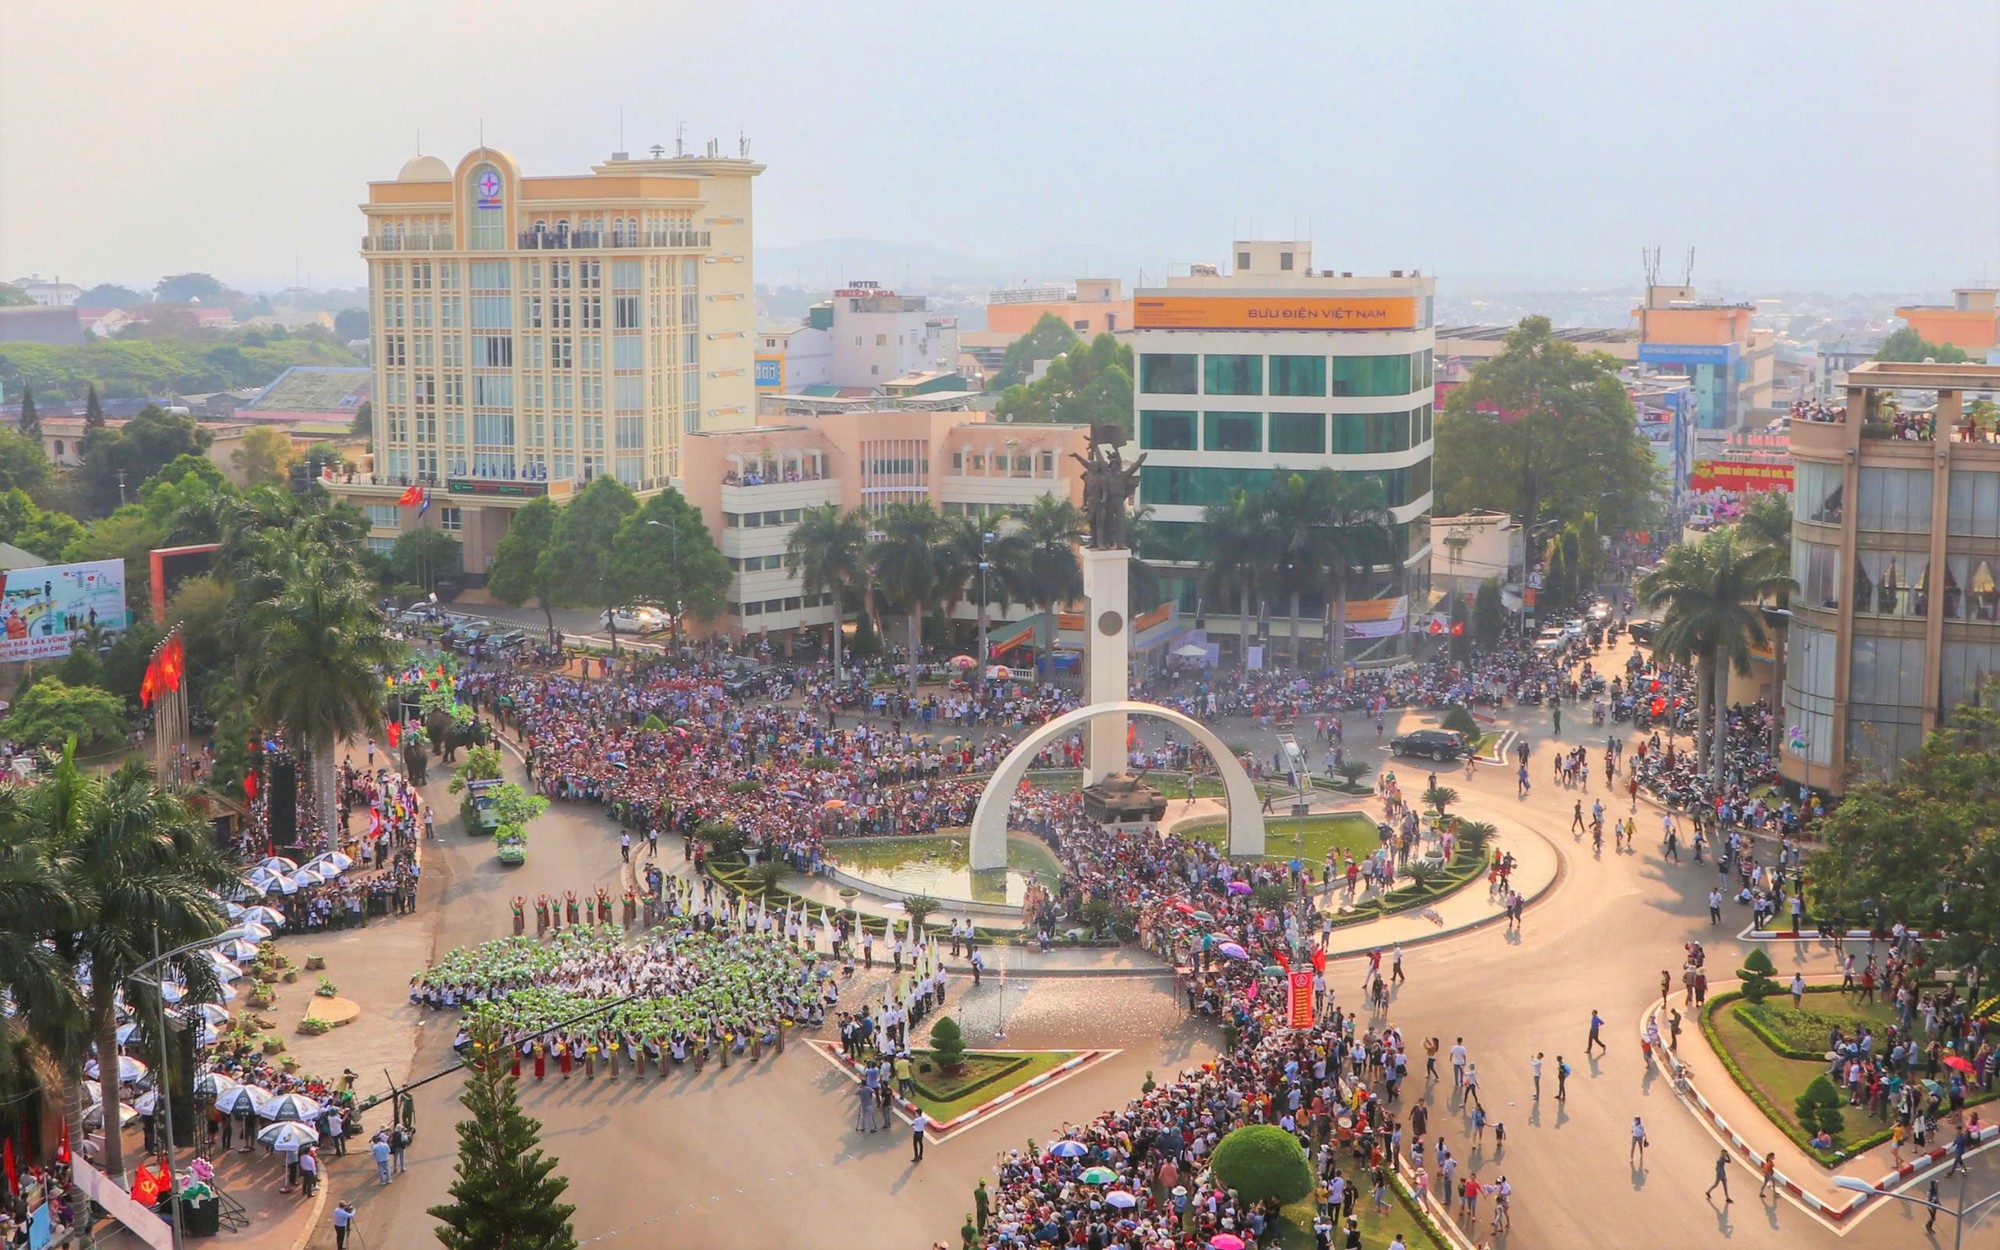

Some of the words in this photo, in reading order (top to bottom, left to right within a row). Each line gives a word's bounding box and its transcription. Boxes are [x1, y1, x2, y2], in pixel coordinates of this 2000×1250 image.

[849, 281, 880, 289] HOTEL
[1282, 306, 1318, 321] ĐIỆN
[1321, 306, 1354, 321] VIỆT
[1356, 310, 1386, 319] NAM
